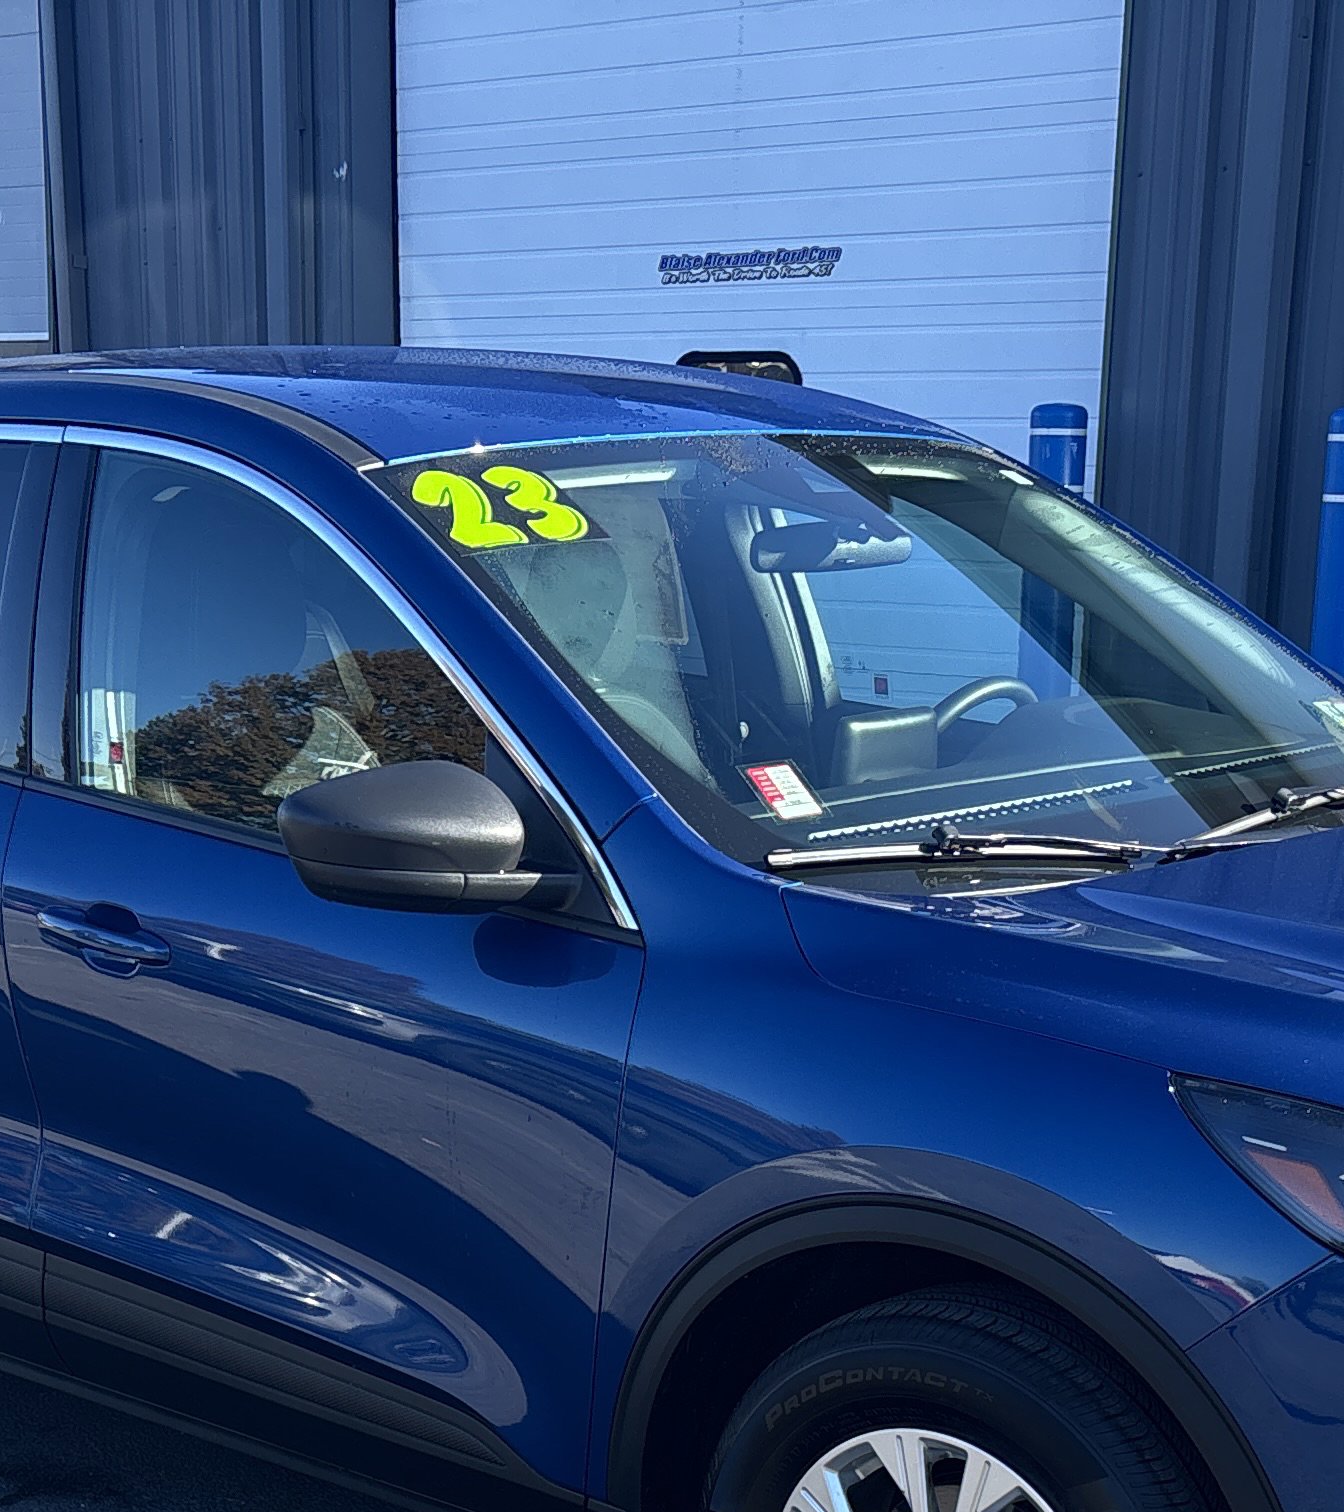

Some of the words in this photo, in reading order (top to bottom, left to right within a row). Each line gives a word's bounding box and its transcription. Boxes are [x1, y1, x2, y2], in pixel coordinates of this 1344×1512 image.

[659, 254, 703, 272] Blaise
[703, 250, 775, 270] Alexander
[411, 466, 590, 549] 23
